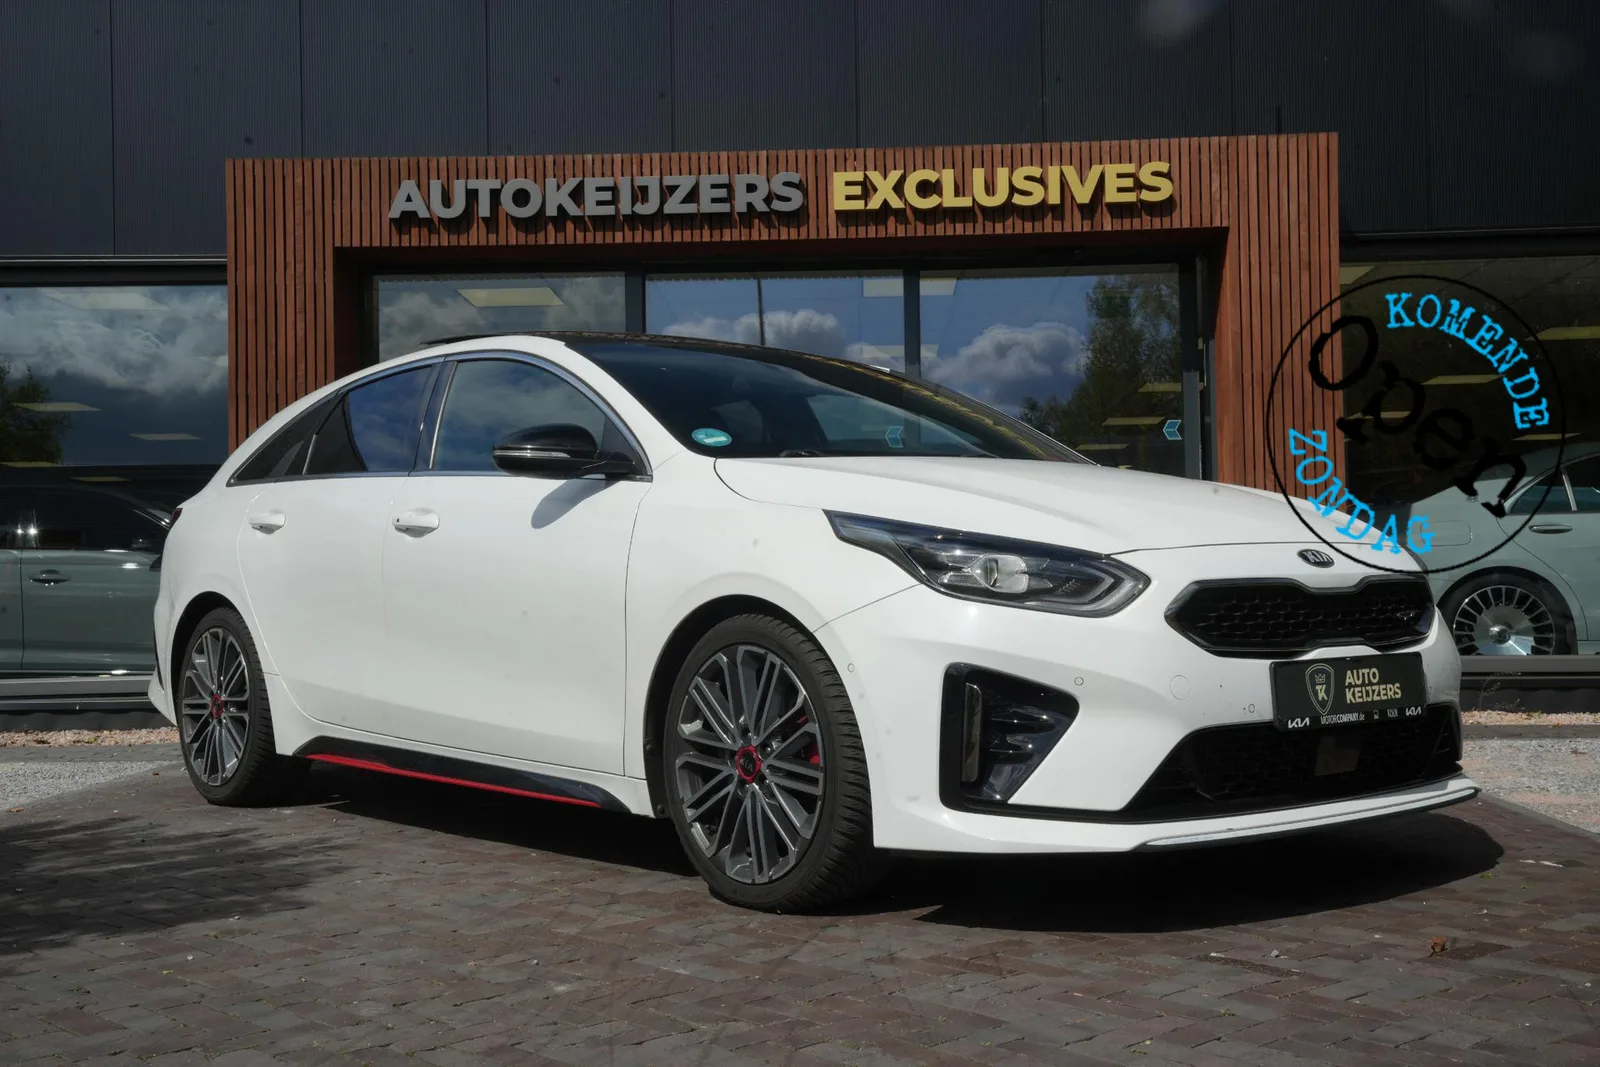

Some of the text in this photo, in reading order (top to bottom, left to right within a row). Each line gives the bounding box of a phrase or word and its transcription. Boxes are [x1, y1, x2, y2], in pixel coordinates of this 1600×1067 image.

[387, 162, 1174, 219] AUTOKEIJZERS EXCLUSIVES
[1301, 550, 1334, 563] KIA
[1345, 667, 1379, 686] AUTO
[1345, 683, 1402, 704] KEIJZERS
